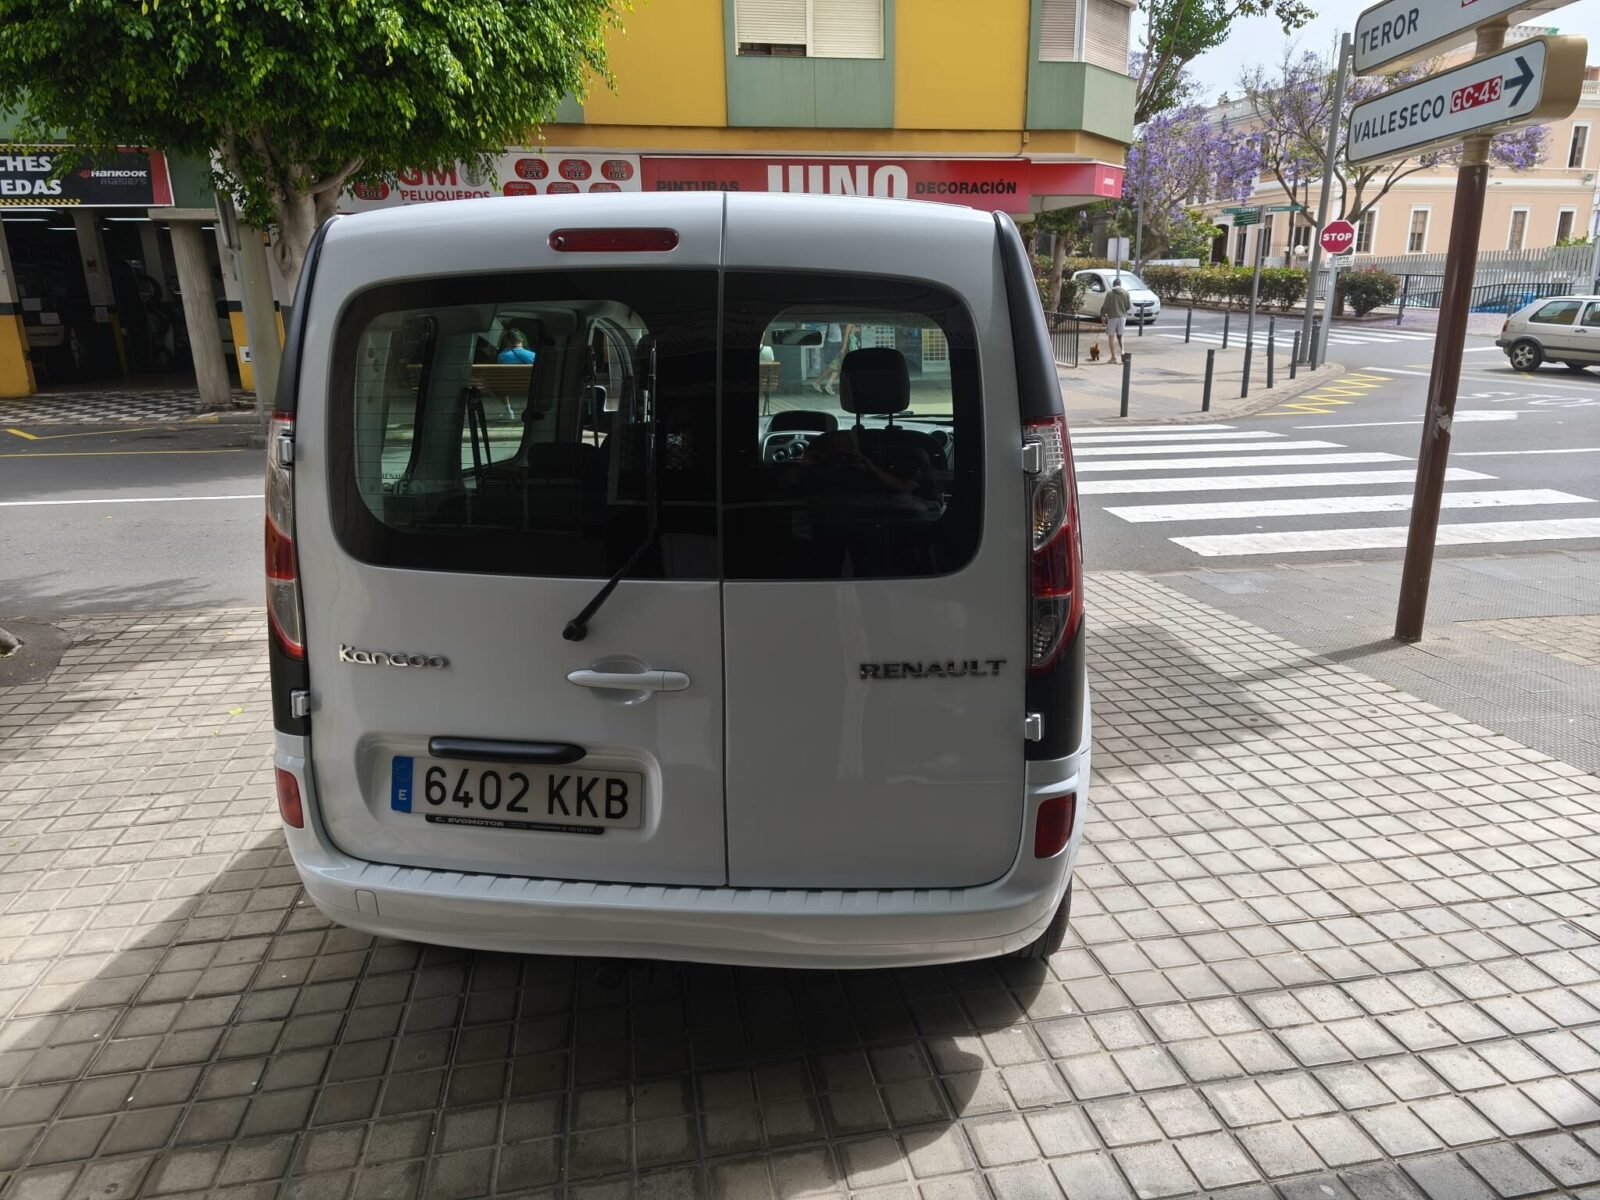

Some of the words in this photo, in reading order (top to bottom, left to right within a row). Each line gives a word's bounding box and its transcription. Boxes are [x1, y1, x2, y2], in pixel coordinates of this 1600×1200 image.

[1360, 8, 1419, 55] TEROR
[1353, 95, 1445, 143] VALLESECO
[1451, 77, 1502, 111] GC-43
[524, 170, 541, 178] 25€
[656, 180, 740, 192] PINTURAS
[915, 178, 1017, 195] DECORACIÓN
[401, 190, 491, 201] PELUQUEROS
[1322, 232, 1353, 242] STOP
[860, 659, 1007, 680] RENAULT
[398, 788, 407, 801] E
[424, 765, 530, 813] 6402
[547, 773, 629, 820] KKB
